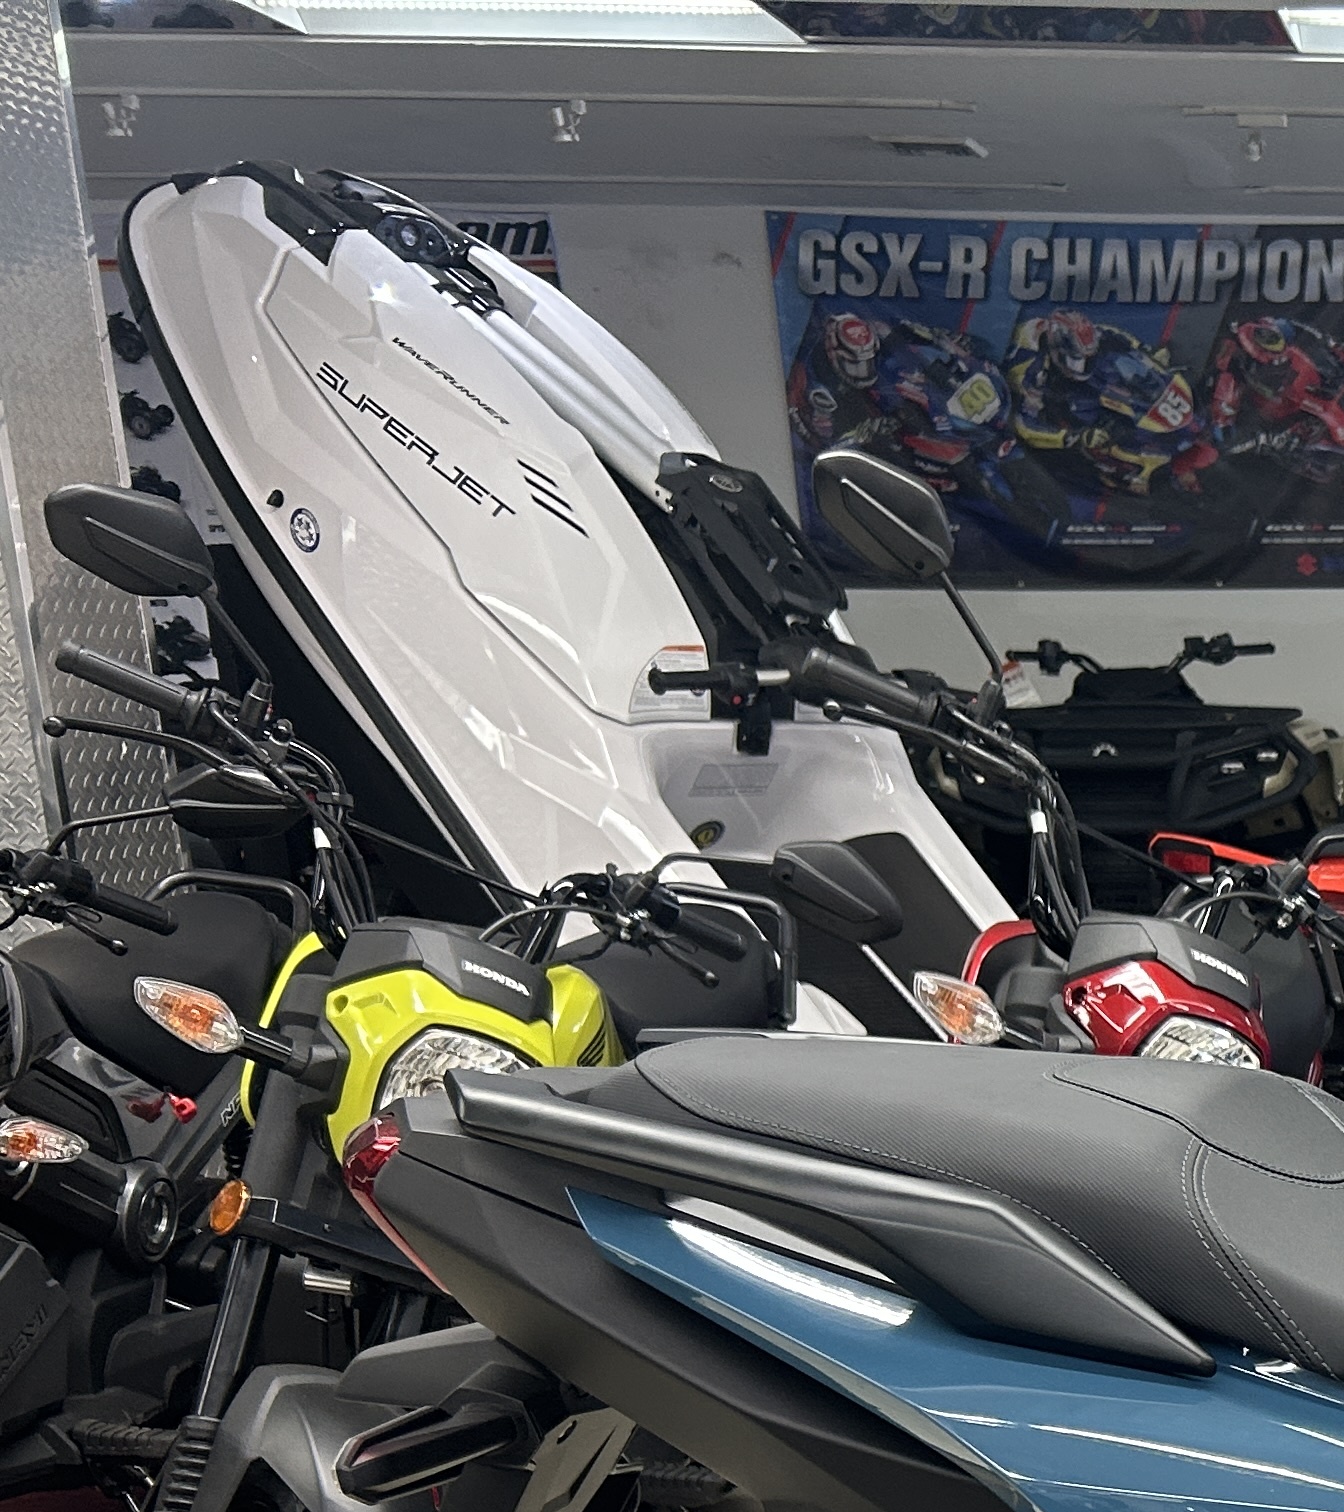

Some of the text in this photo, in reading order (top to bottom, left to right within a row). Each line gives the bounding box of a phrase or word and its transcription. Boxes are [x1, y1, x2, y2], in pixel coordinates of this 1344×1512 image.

[798, 229, 988, 300] GSX-R
[316, 361, 516, 517] SUPERJET
[461, 959, 531, 998] HONDA
[1189, 947, 1250, 988] HONDA
